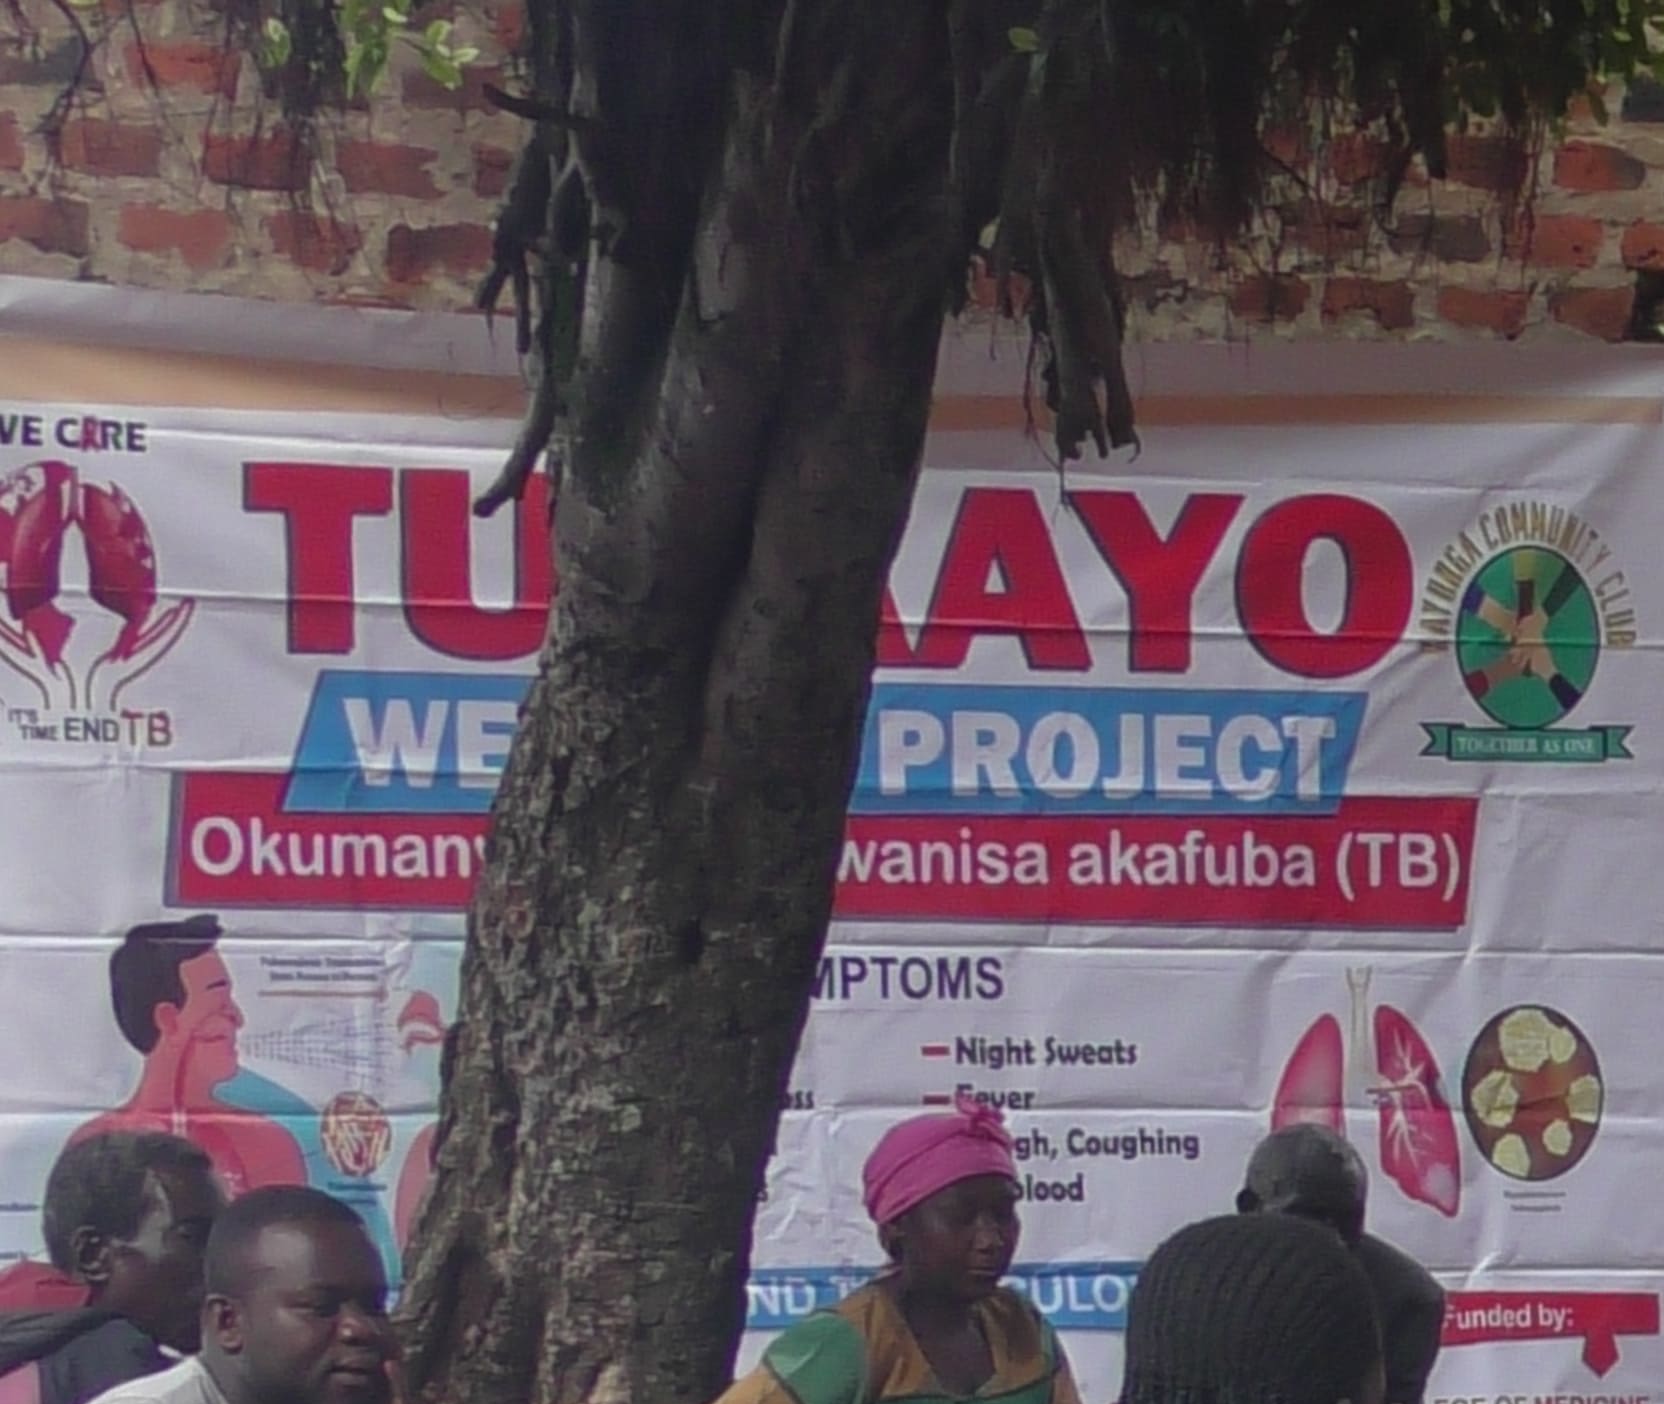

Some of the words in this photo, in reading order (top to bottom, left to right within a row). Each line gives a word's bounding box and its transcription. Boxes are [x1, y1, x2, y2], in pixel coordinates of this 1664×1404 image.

[64, 717, 120, 742] END
[120, 709, 172, 747] TB
[1543, 738, 1561, 753] AS
[879, 710, 1336, 801] PROJECT
[836, 827, 1049, 886] wanisa
[1068, 829, 1316, 888] akafuba
[1336, 832, 1461, 902] (TB)
[812, 957, 1004, 1001] MPTOMS
[955, 1037, 1036, 1069] Night
[1045, 1037, 1138, 1066] Sweats
[1066, 1128, 1200, 1160] Coughing
[1538, 1303, 1574, 1332] by:
